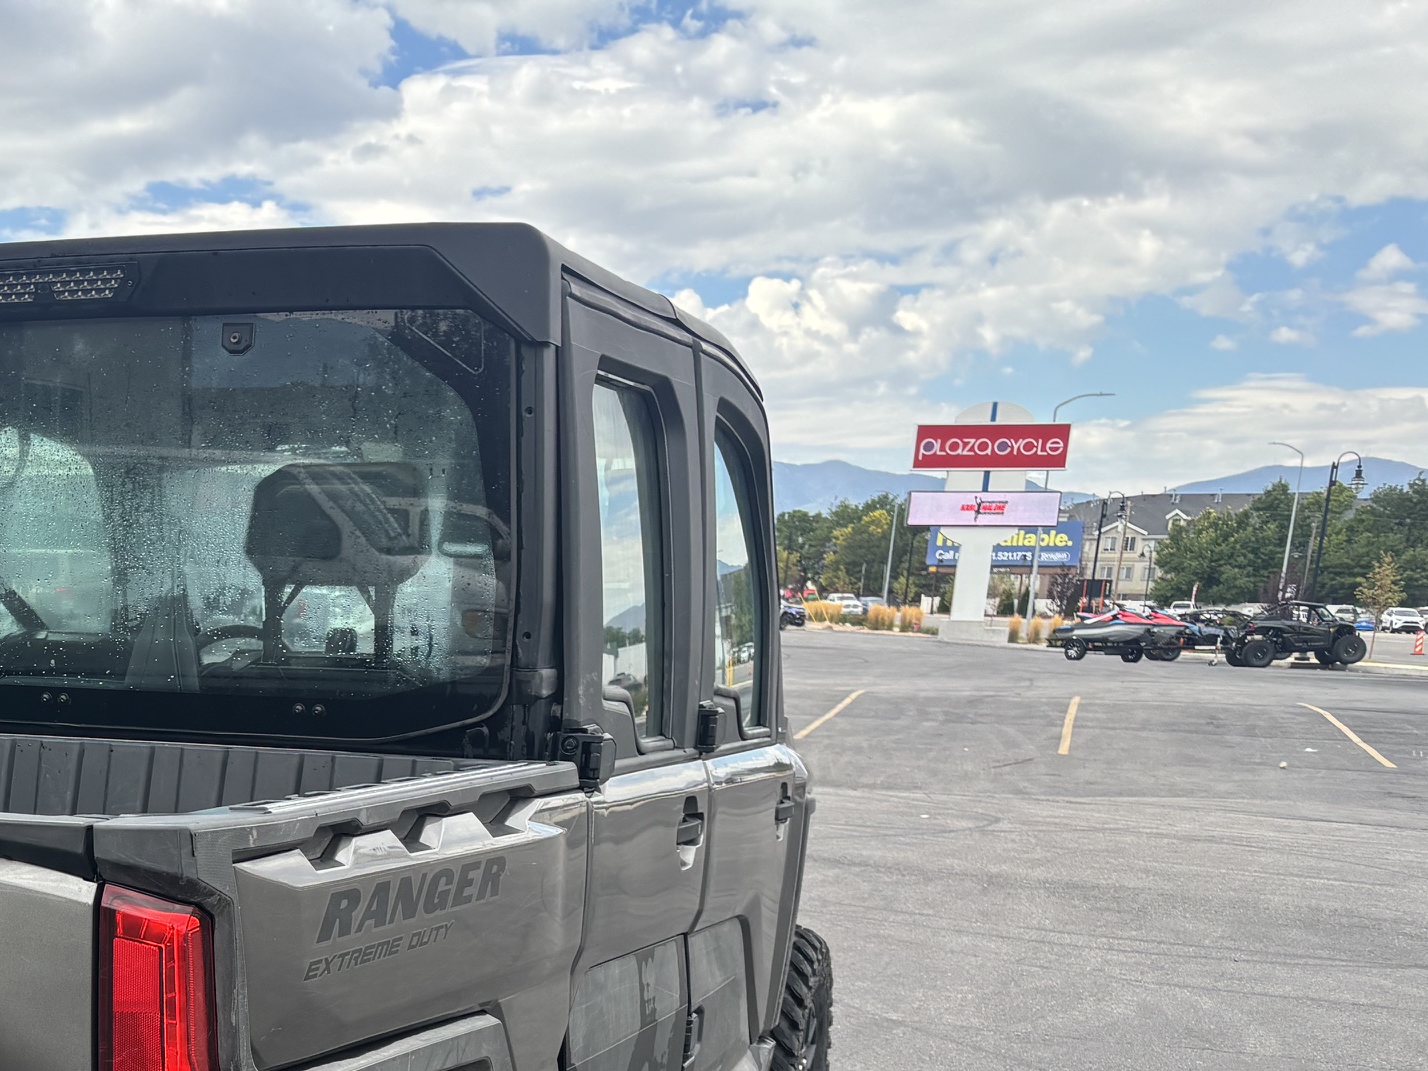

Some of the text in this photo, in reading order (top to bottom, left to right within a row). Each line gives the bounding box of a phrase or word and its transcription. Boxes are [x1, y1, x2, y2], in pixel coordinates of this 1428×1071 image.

[935, 549, 955, 561] Call
[315, 855, 507, 944] RANGER
[303, 920, 455, 982] EXTREME DUTY
